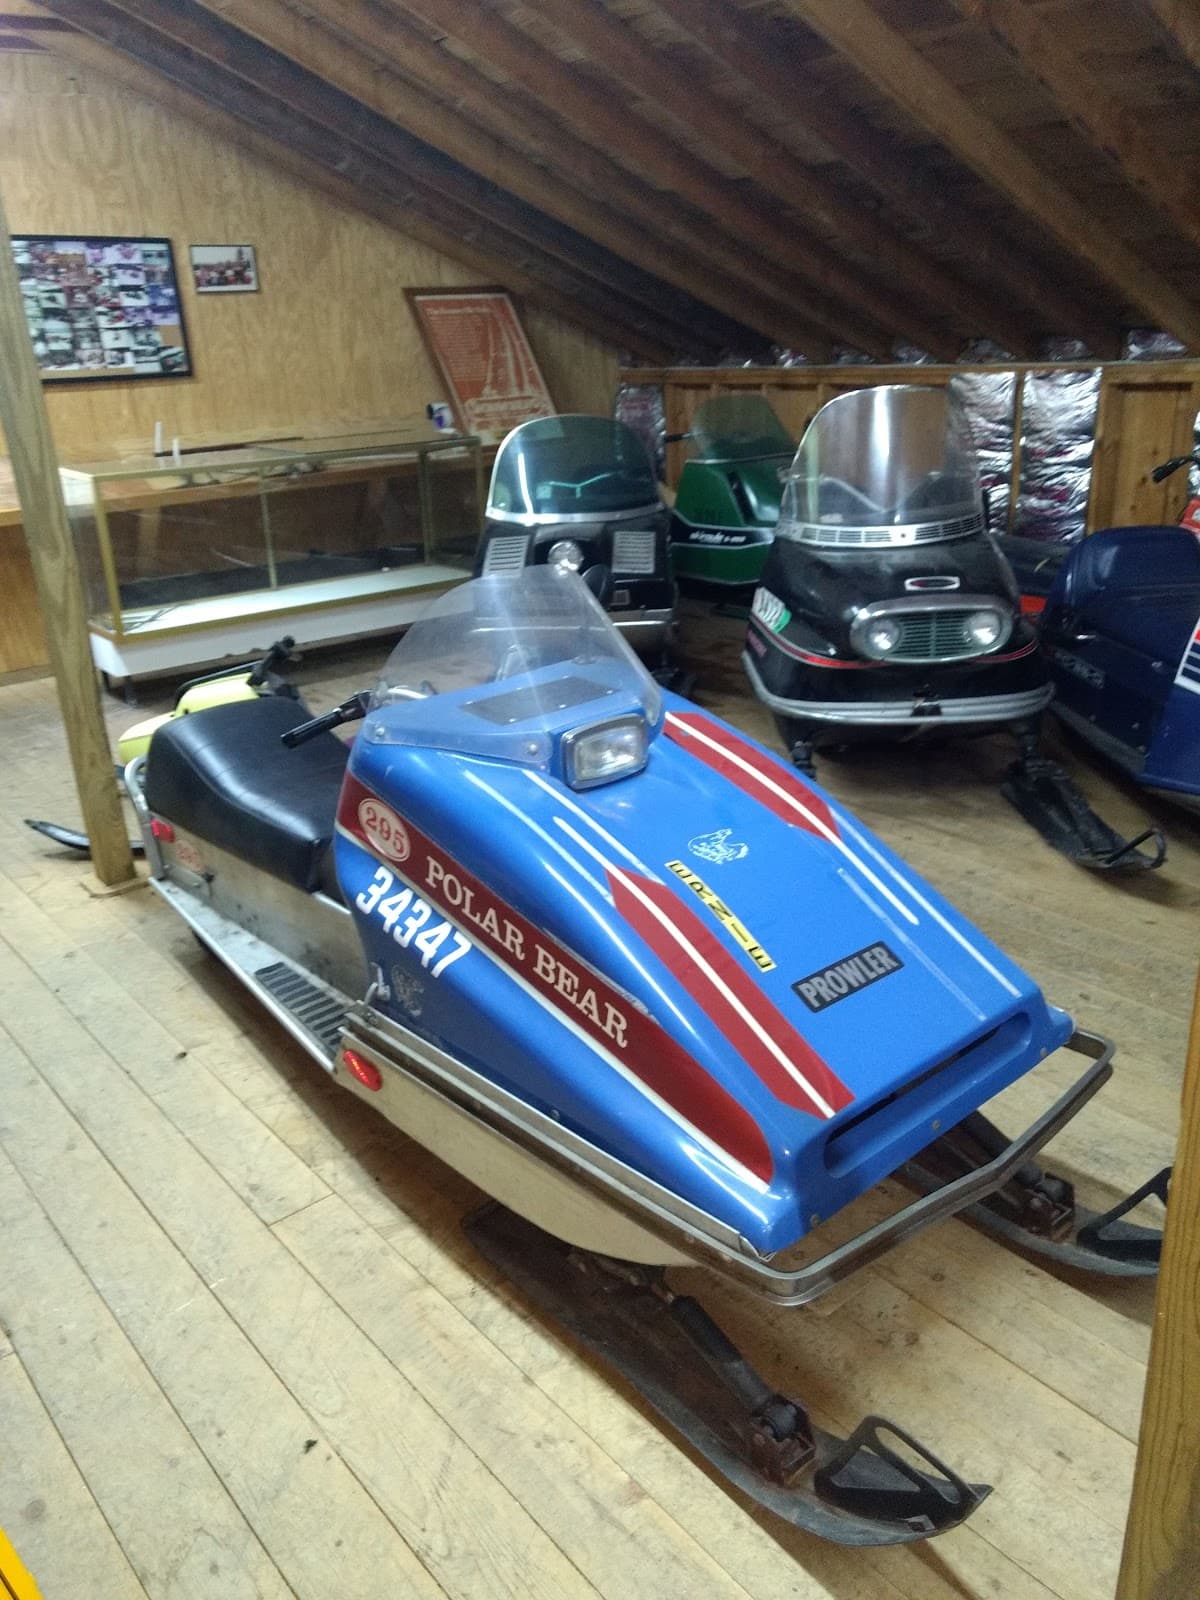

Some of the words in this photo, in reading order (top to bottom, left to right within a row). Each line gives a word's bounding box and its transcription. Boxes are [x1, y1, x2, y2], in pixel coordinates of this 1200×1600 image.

[365, 806, 404, 854] 295
[356, 866, 472, 979] 34347
[425, 856, 525, 961] POLAR
[533, 944, 629, 1049] BEAR
[669, 862, 772, 968] ERNIE
[798, 946, 898, 1009] PROWLER
